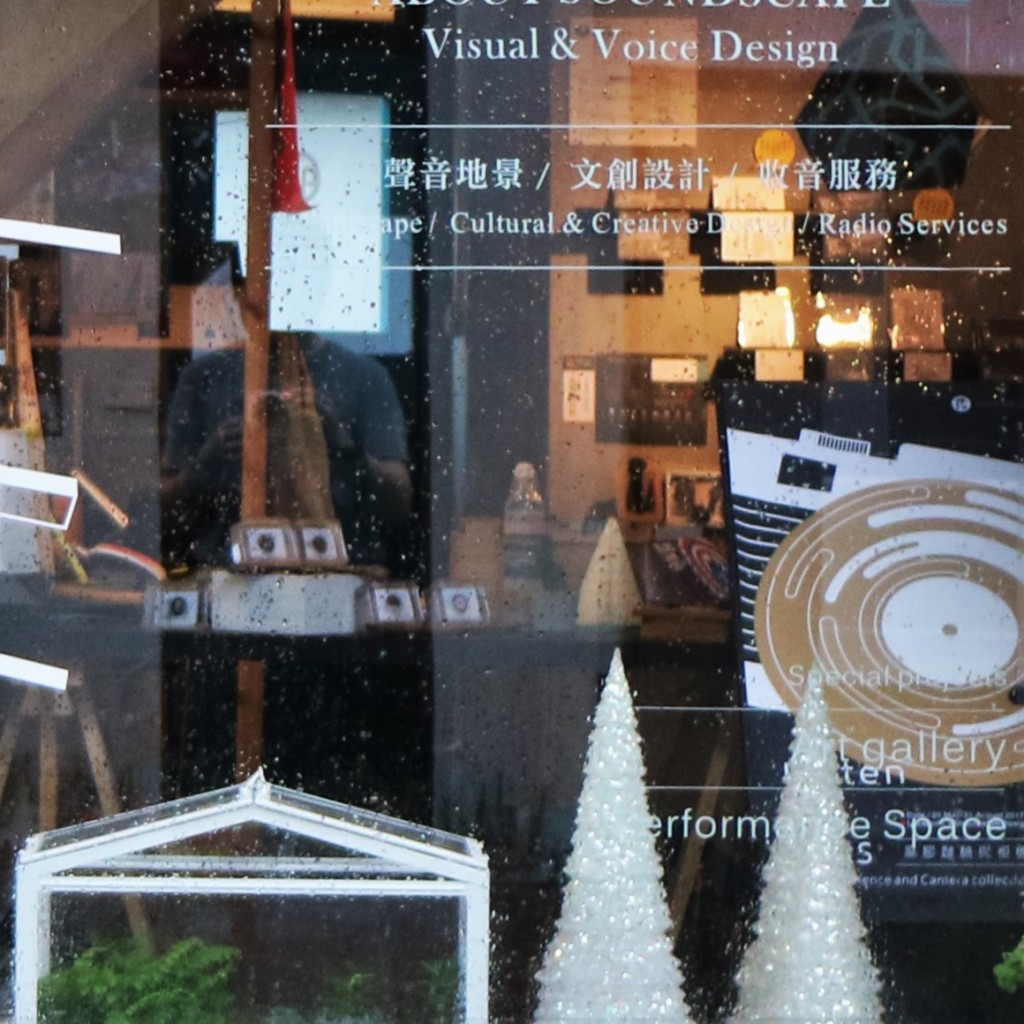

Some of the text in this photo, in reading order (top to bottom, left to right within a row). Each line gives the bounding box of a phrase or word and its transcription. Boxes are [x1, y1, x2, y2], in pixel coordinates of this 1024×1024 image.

[422, 27, 839, 68] Visual & Voice Design
[383, 157, 522, 191] 聲音地景
[570, 157, 710, 191] 文創設計
[758, 157, 898, 192] 收音服務
[450, 212, 554, 235] Cultural
[562, 213, 584, 235] &
[592, 212, 699, 235] Creative
[818, 212, 891, 235] Radio
[899, 213, 1008, 236] Services
[862, 729, 1007, 771] gallery
[882, 808, 1007, 850] Space
